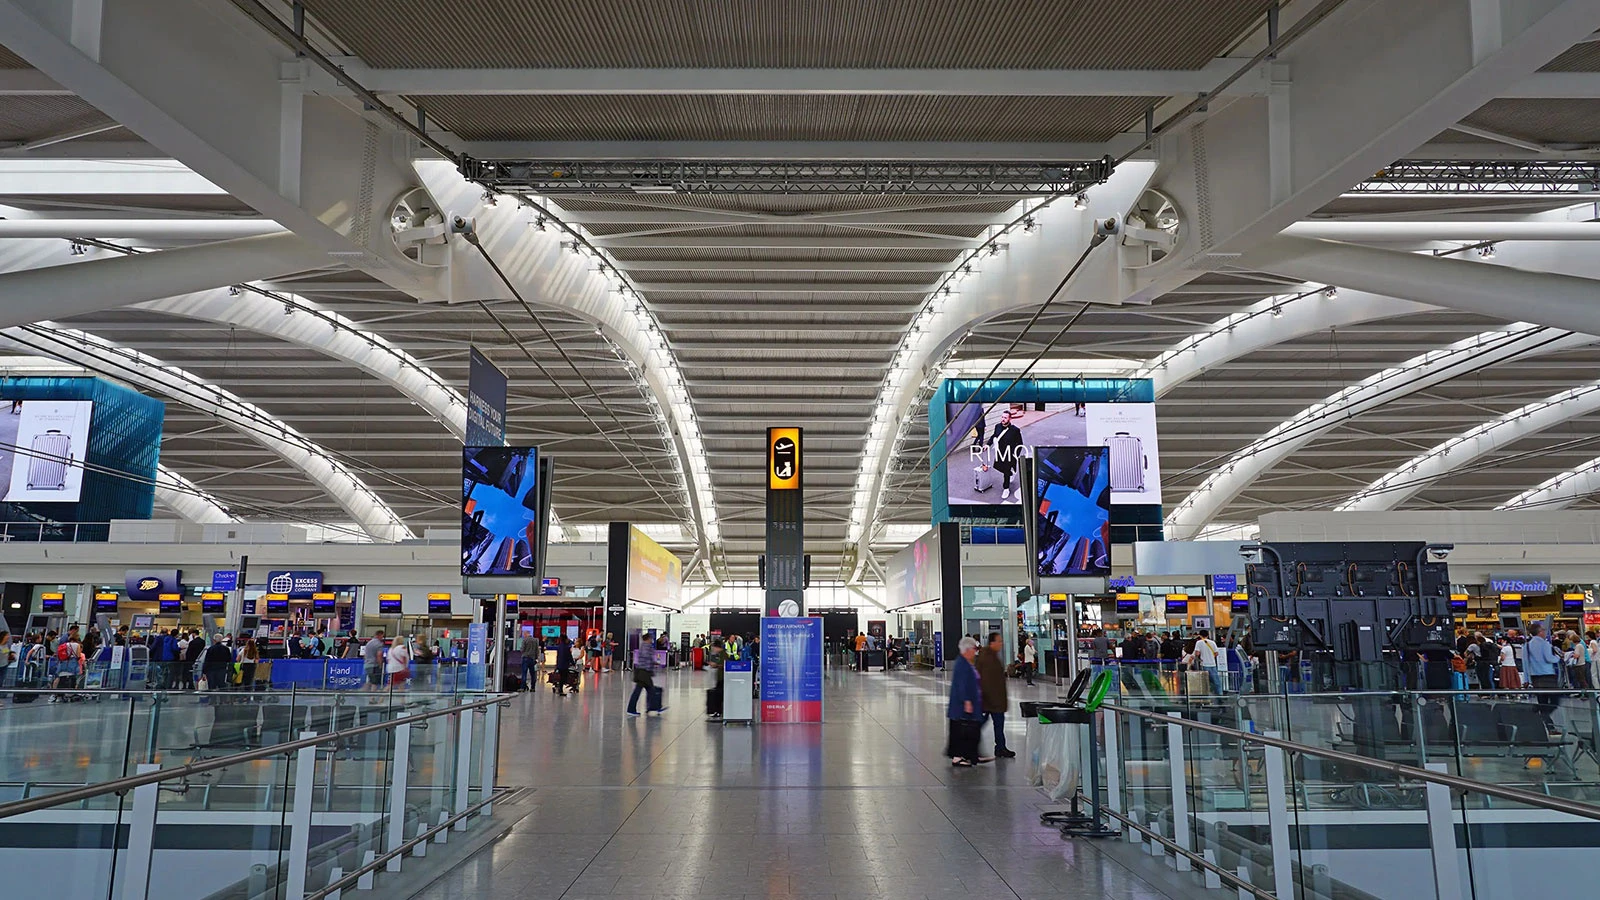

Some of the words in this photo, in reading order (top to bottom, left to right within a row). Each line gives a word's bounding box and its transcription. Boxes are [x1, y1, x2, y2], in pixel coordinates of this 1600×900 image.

[469, 390, 490, 416] HARNESS
[490, 407, 502, 425] YOUR
[469, 407, 485, 430] DIGITAL
[970, 444, 1036, 463] RIMO
[1491, 580, 1548, 592] WHSmith
[330, 667, 351, 675] Hand
